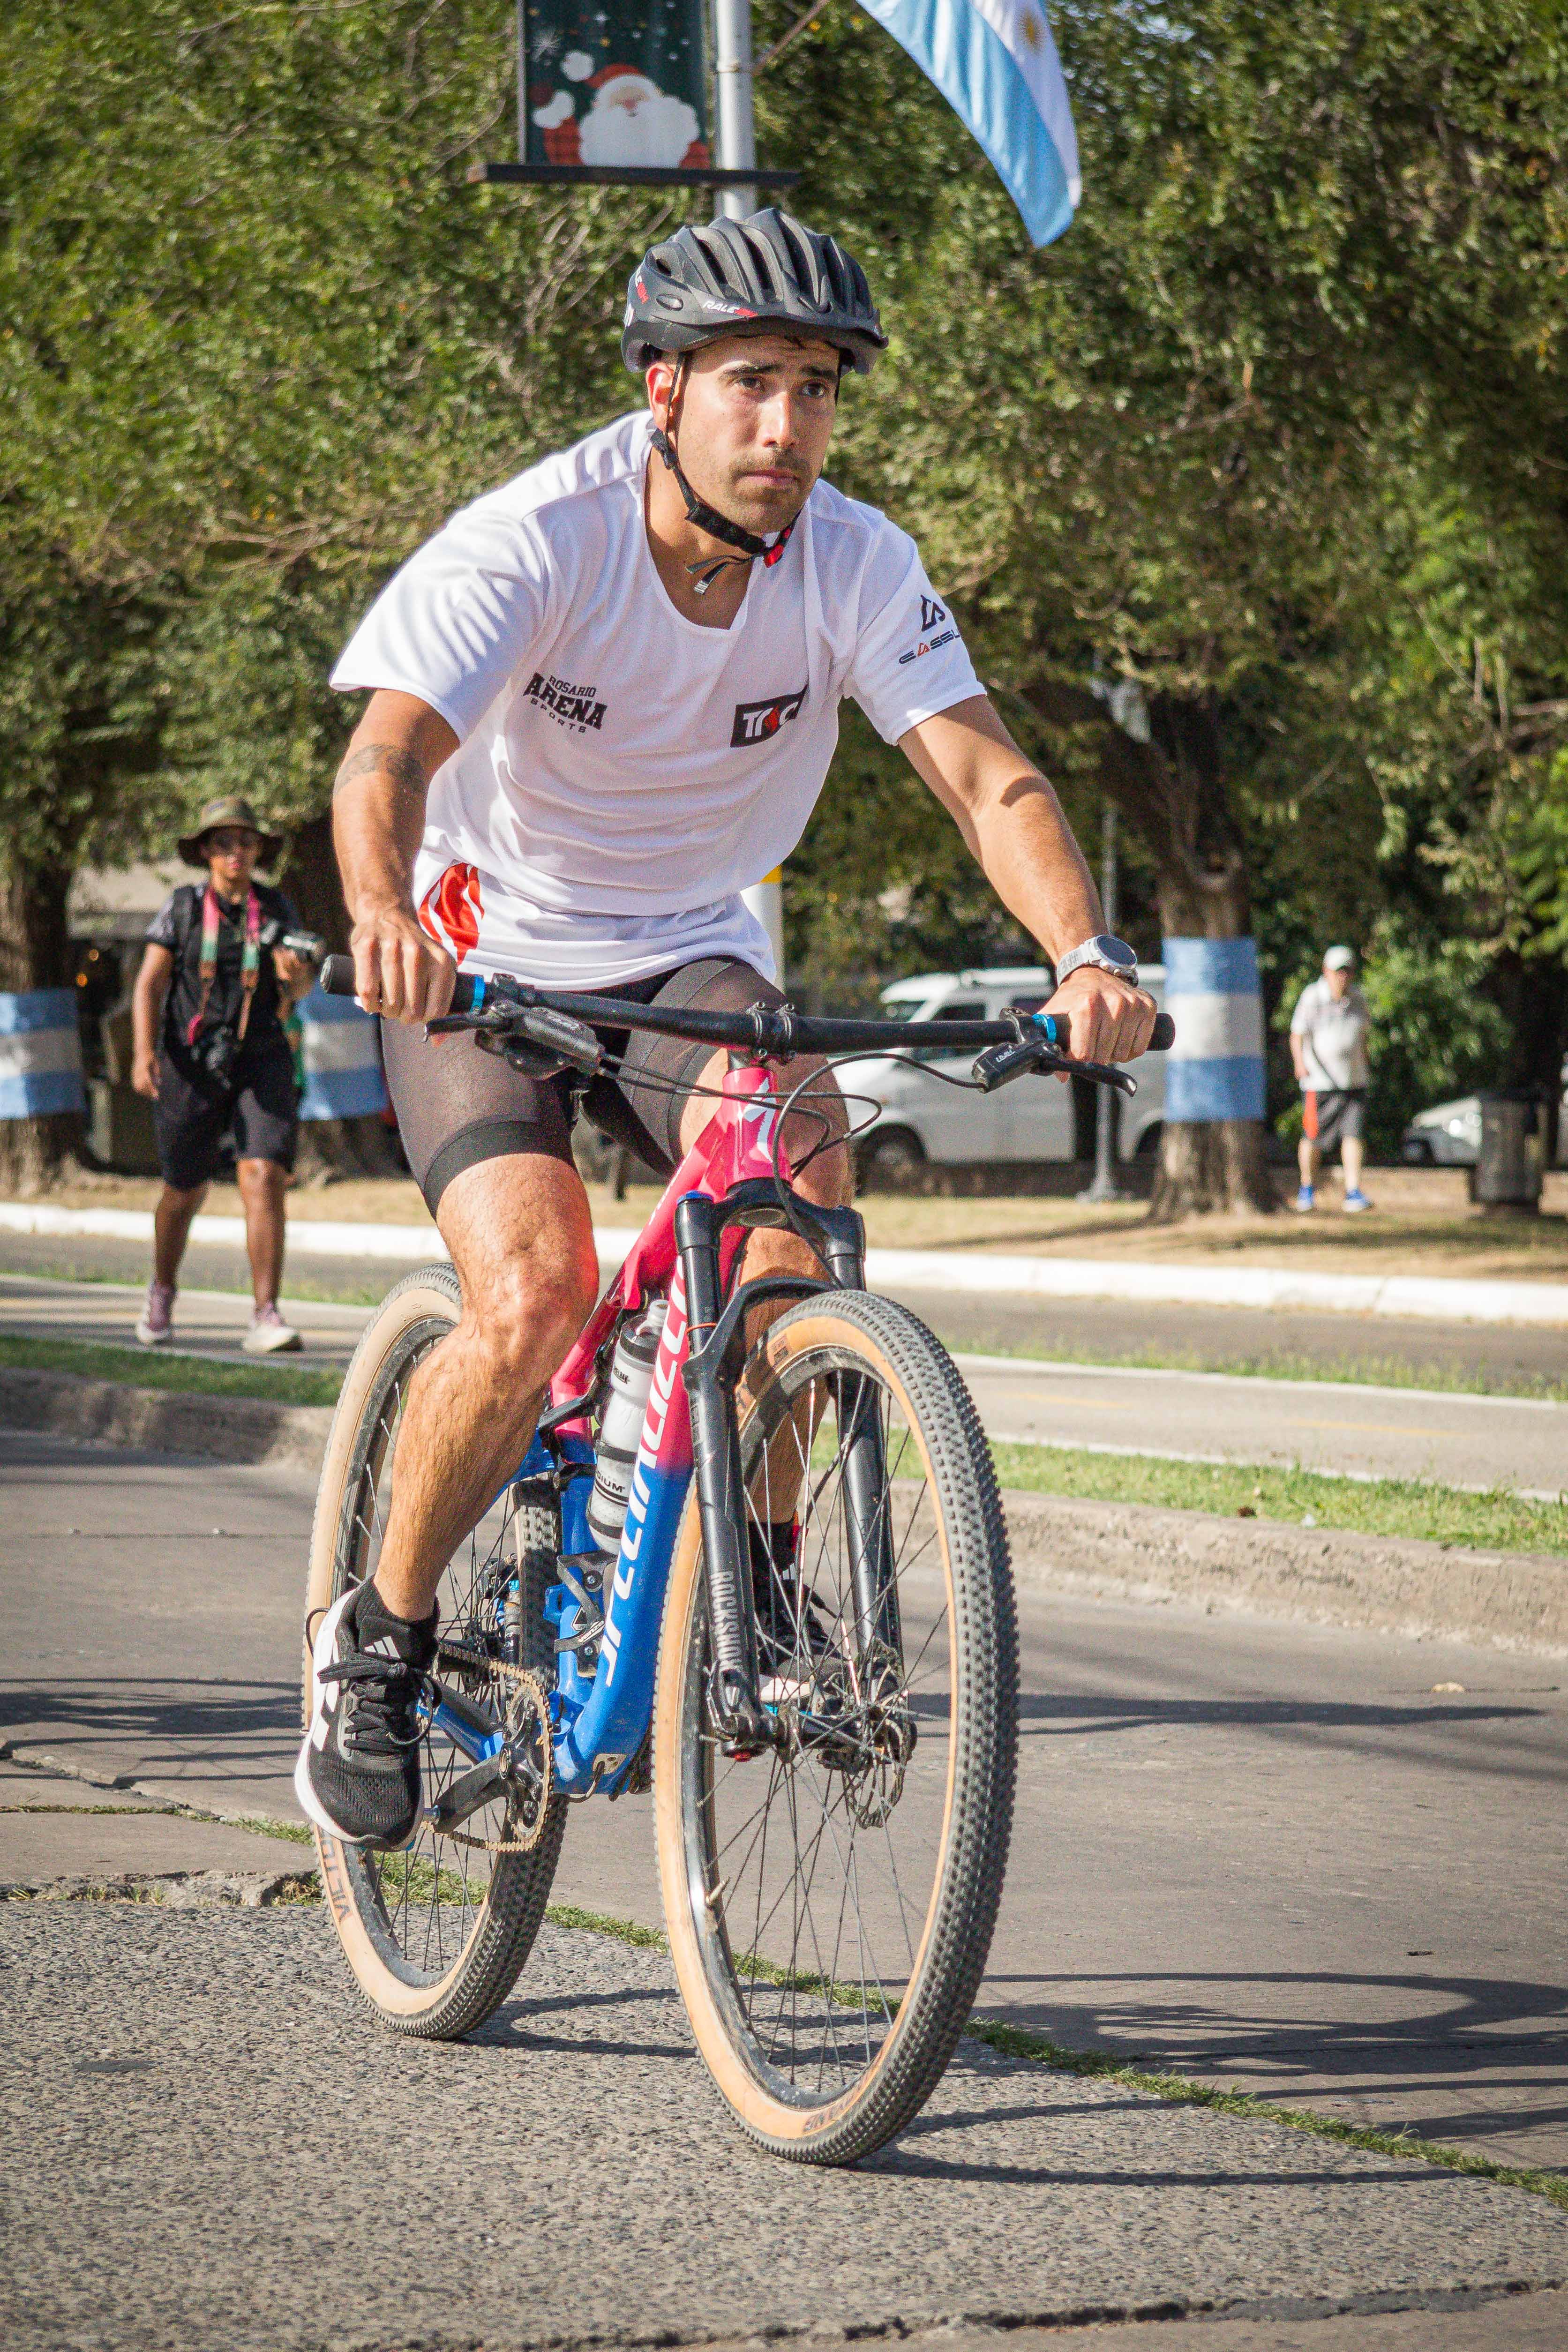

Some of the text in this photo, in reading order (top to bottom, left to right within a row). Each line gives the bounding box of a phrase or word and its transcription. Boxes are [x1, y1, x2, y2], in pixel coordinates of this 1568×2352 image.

[523, 672, 608, 730] ARENA
[549, 675, 597, 697] ROSARIO
[531, 697, 586, 733] SPORTS
[710, 1570, 744, 1676] ROCKSHOX
